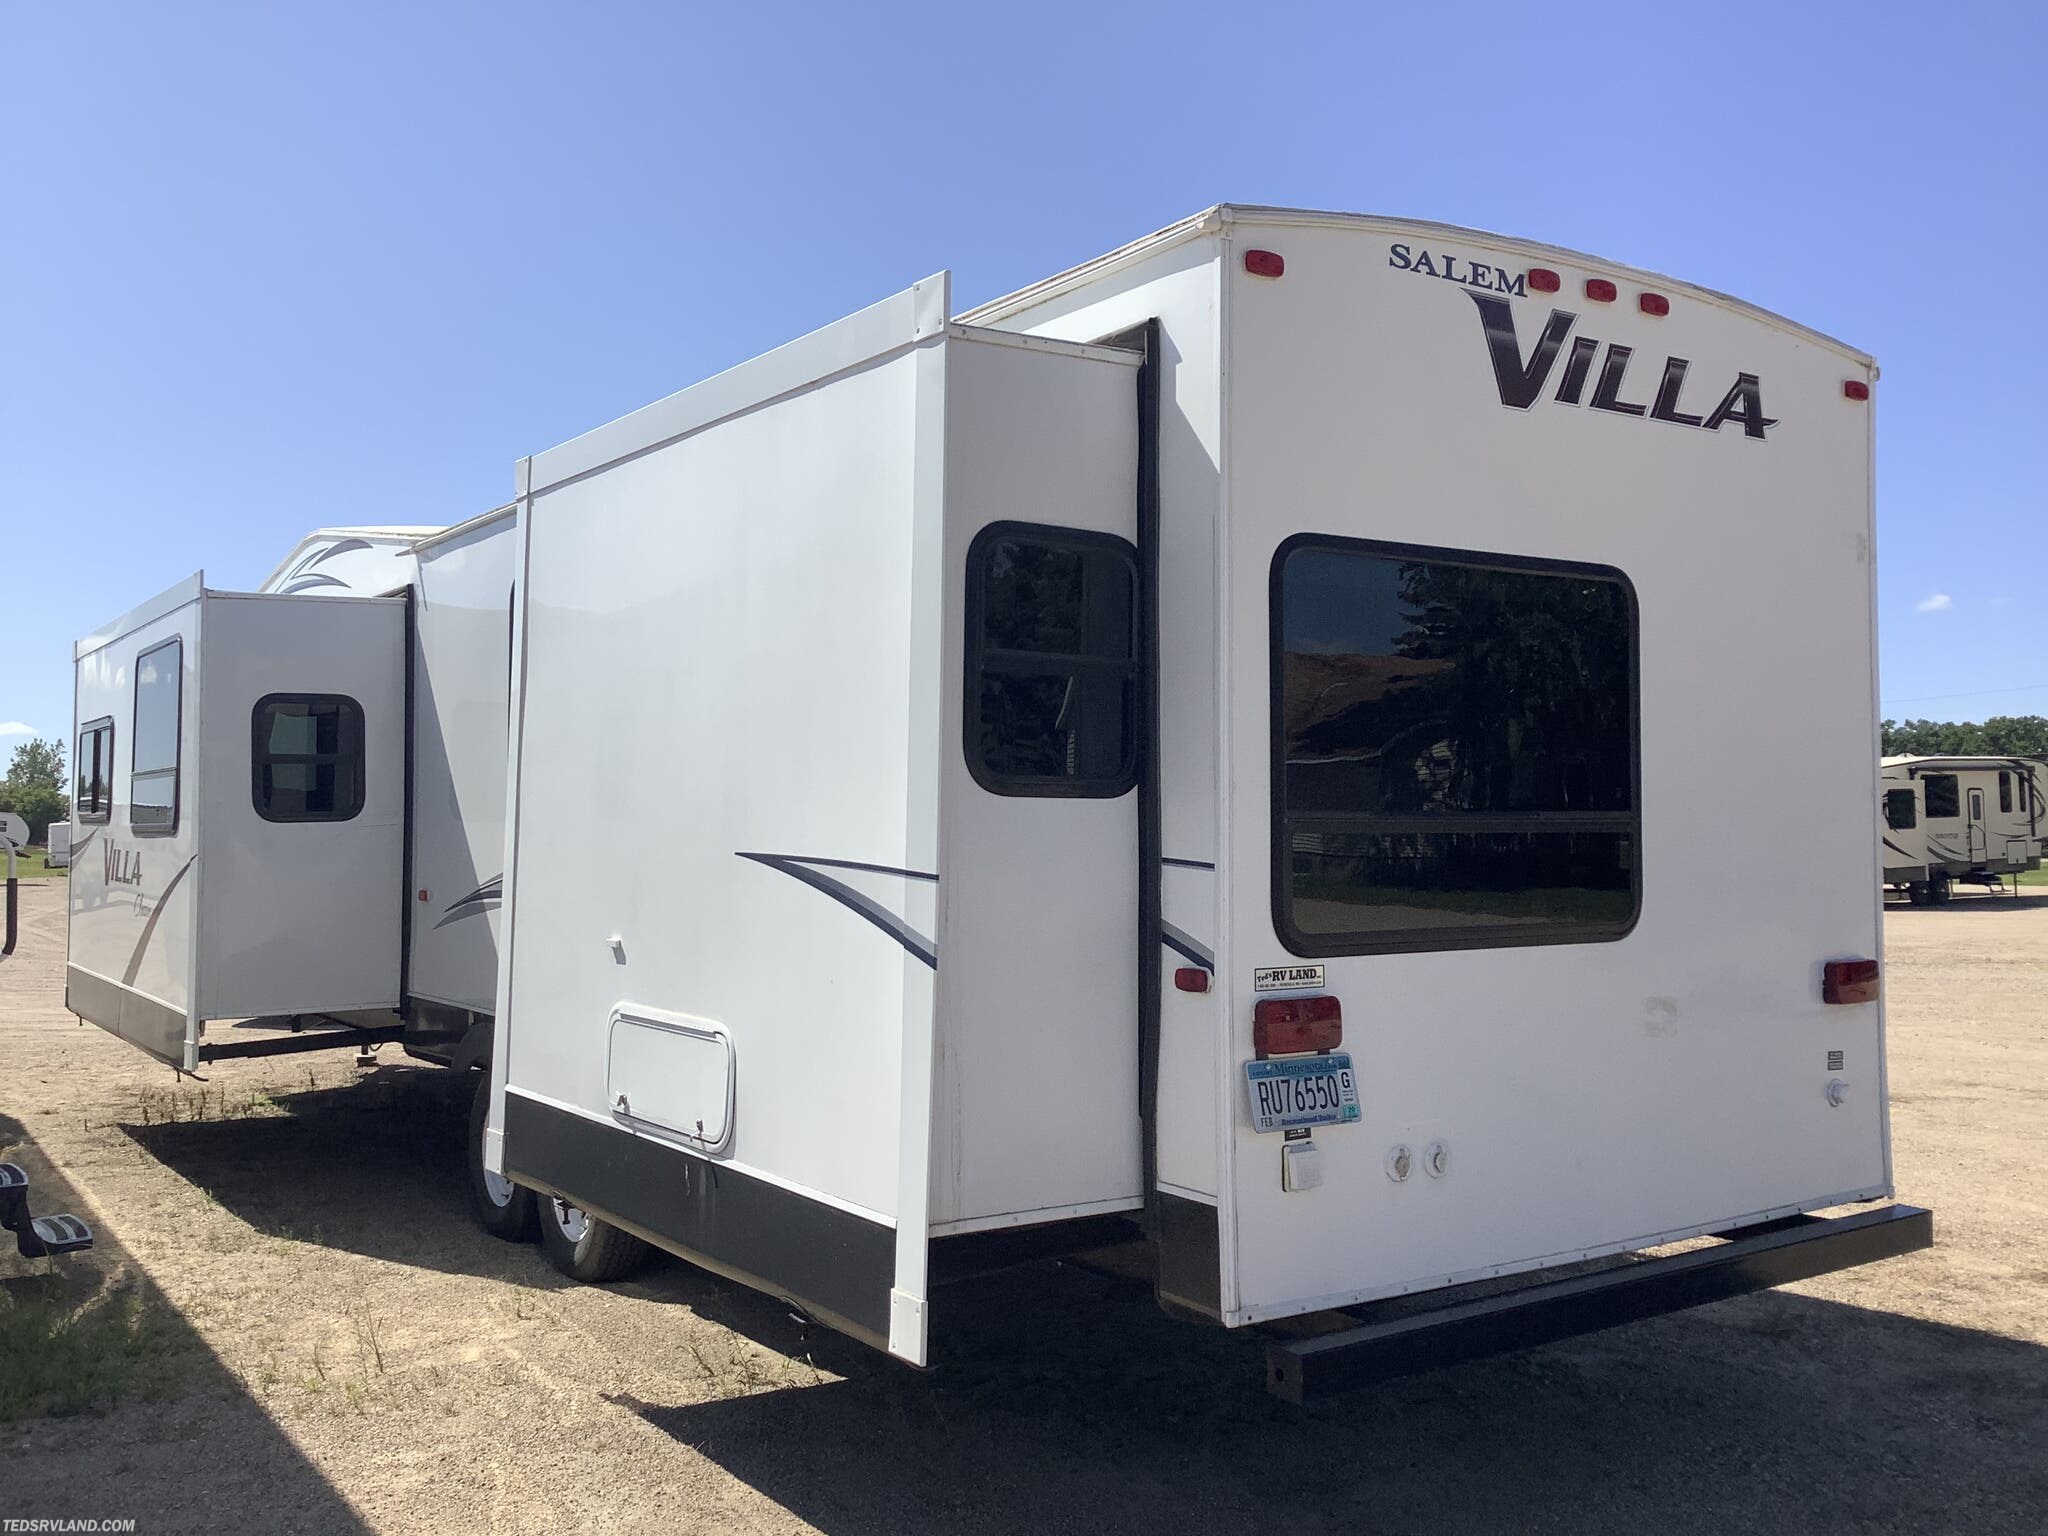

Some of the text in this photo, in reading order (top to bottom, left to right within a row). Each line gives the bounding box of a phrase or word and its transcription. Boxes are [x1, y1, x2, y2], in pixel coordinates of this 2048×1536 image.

[1389, 243, 1528, 298] SALEM
[1459, 287, 1781, 441] VILLA
[103, 837, 143, 887] VILLA
[1272, 970, 1288, 982] RV
[1288, 968, 1317, 981] LAND
[1274, 1061, 1323, 1074] Minnesota
[1341, 1071, 1351, 1089] G
[1257, 1075, 1340, 1116] RU76550
[1260, 1116, 1274, 1128] FEB
